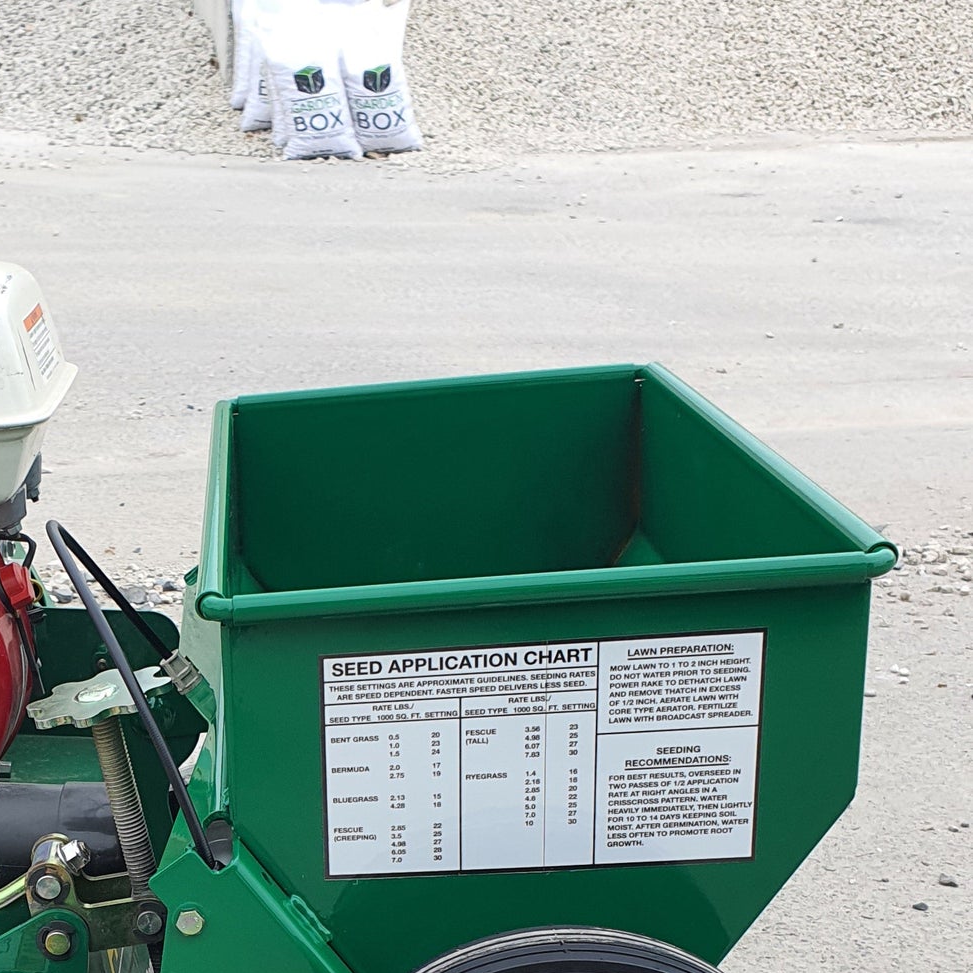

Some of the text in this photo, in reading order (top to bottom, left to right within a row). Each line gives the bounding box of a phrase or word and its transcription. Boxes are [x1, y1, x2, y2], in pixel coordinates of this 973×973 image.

[294, 109, 344, 132] BOX
[356, 107, 406, 130] BOX
[627, 643, 734, 657] LAWN PREPARATION:
[332, 648, 593, 677] SEED APPLICATION CHART
[633, 663, 657, 671] LAWN
[698, 659, 718, 667] INCH
[720, 657, 751, 666] HEIGHT.
[643, 671, 670, 679] WATER
[713, 667, 751, 675] SEEDING.
[329, 685, 355, 693] THESE
[357, 683, 396, 691] SETTINGS
[416, 679, 475, 688] APPROXIMATE
[477, 675, 528, 683] GUIDELINES.
[530, 672, 567, 680] SEEDING
[569, 670, 596, 678] RATES
[641, 680, 663, 688] RAKE
[678, 677, 722, 686] DETHATCH
[723, 675, 747, 683] LAWN
[355, 692, 381, 700] SPEED
[384, 689, 434, 698] DEPENDENT.
[436, 687, 467, 695] FASTER
[499, 683, 538, 692] DELIVERS
[628, 689, 662, 697] REMOVE
[709, 685, 741, 693] EXCESS
[659, 696, 691, 704] AERATE
[693, 694, 717, 702] LAWN
[562, 702, 596, 710] SETTING
[656, 705, 695, 713] AERATOR.
[698, 702, 738, 710] FERTILIZE
[424, 710, 458, 718] SETTING
[656, 712, 705, 722] BROADCAST
[708, 710, 753, 718] SPREADER.
[353, 735, 379, 743] GRASS
[465, 738, 489, 746] (TALL)
[656, 745, 701, 755] SEEDING
[625, 755, 732, 768] RECOMMENDATIONS:
[649, 772, 686, 780] RESULTS,
[688, 769, 731, 778] OVERSEED
[332, 796, 379, 804] BLUEGRASS
[334, 834, 377, 843] (CREEPING)
